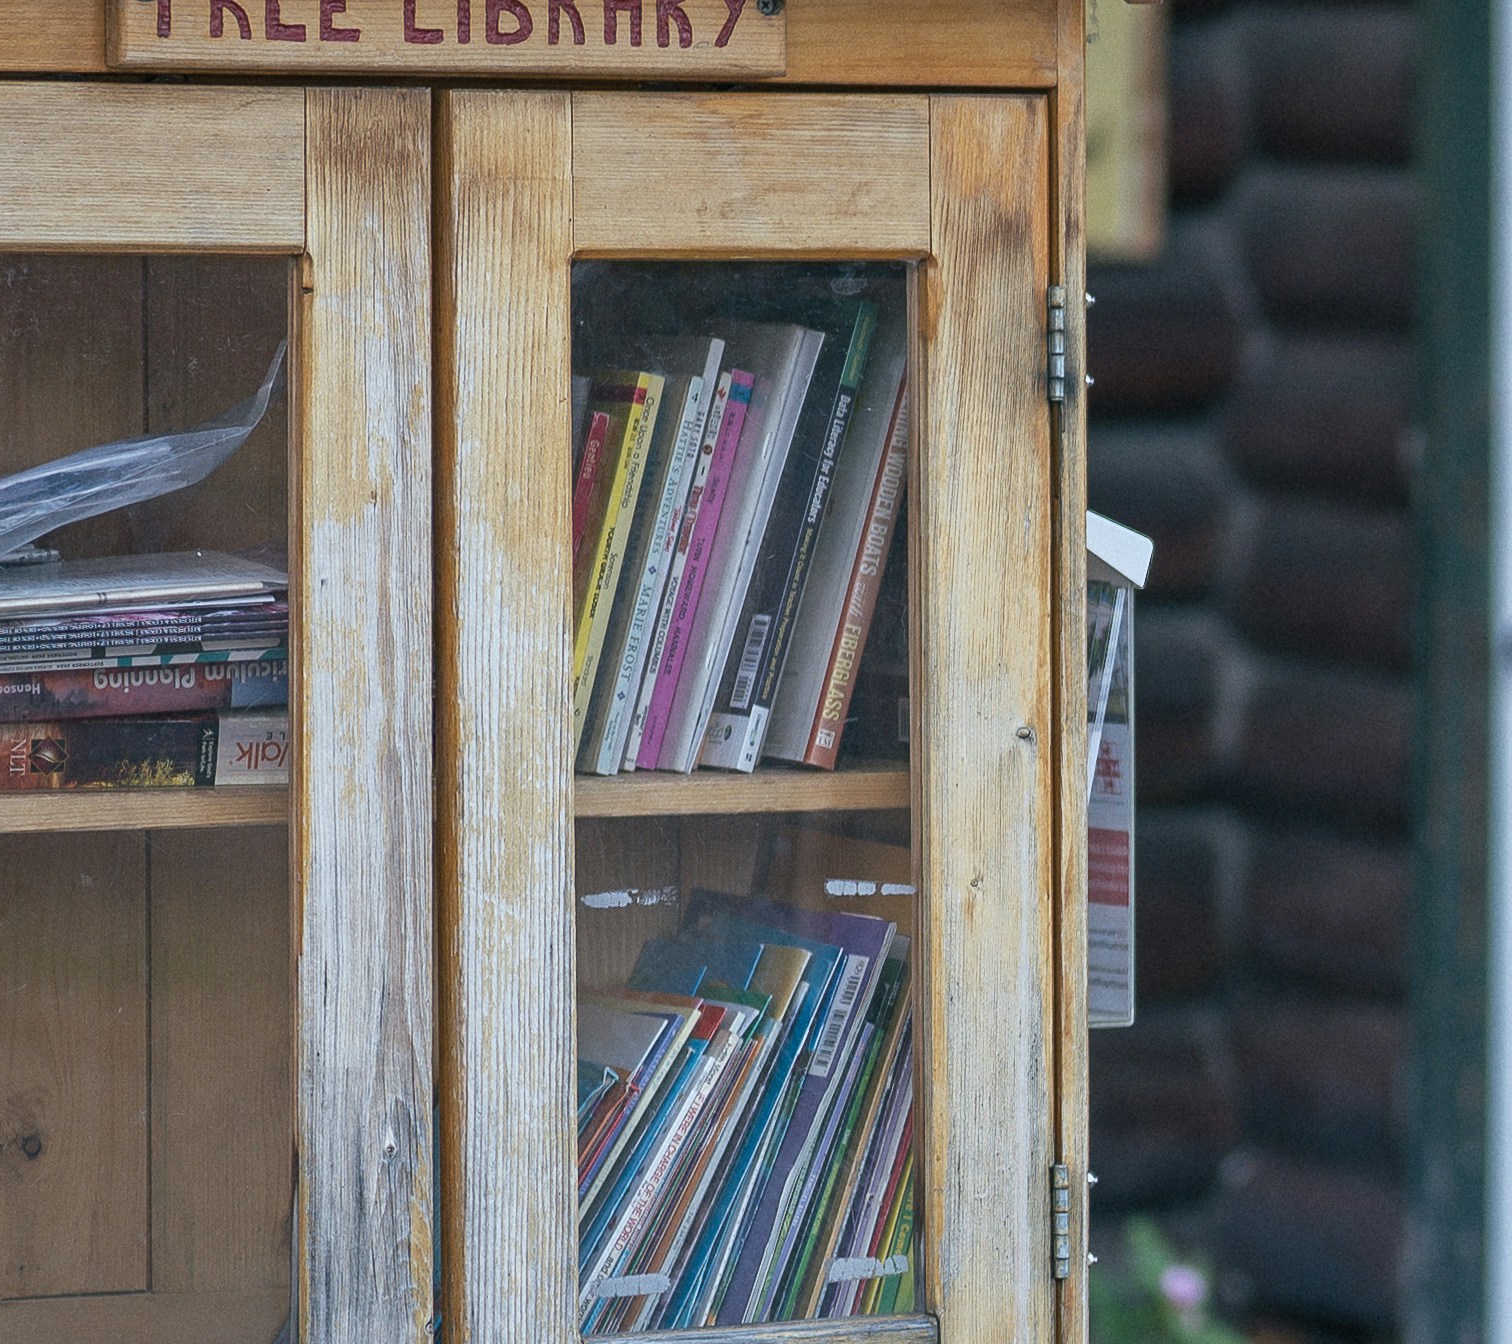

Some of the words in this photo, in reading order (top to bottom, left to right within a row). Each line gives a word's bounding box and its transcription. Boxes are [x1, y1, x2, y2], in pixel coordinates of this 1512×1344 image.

[641, 396, 655, 422] Once
[835, 394, 851, 418] Data
[633, 424, 648, 450] Upon
[822, 418, 844, 458] Literacy
[820, 458, 833, 473] for
[619, 461, 639, 509] Friendship
[807, 474, 829, 524] Educators
[873, 449, 906, 520] WOODEN
[651, 476, 679, 555] ADVENTURES
[692, 536, 705, 561] TURN
[859, 522, 887, 576] BOATS
[603, 552, 617, 590] Sorenson
[665, 575, 678, 606] VOYAGE
[632, 583, 652, 631] MARIE
[619, 635, 640, 682] FROST
[648, 630, 665, 674] COLUMBUS
[663, 626, 682, 676] HANNALEE
[93, 668, 196, 692] Planning
[204, 660, 287, 687] riculum
[821, 622, 861, 721] FIBERGLASS
[8, 738, 26, 776] NLT
[716, 1040, 733, 1063] Judith
[704, 1062, 721, 1085] Viorst
[694, 1091, 705, 1103] IF
[677, 1106, 698, 1134] WERE
[671, 1133, 683, 1144] IN
[649, 1143, 677, 1184] CHARGE
[642, 1182, 655, 1197] OF
[632, 1196, 647, 1216] THE
